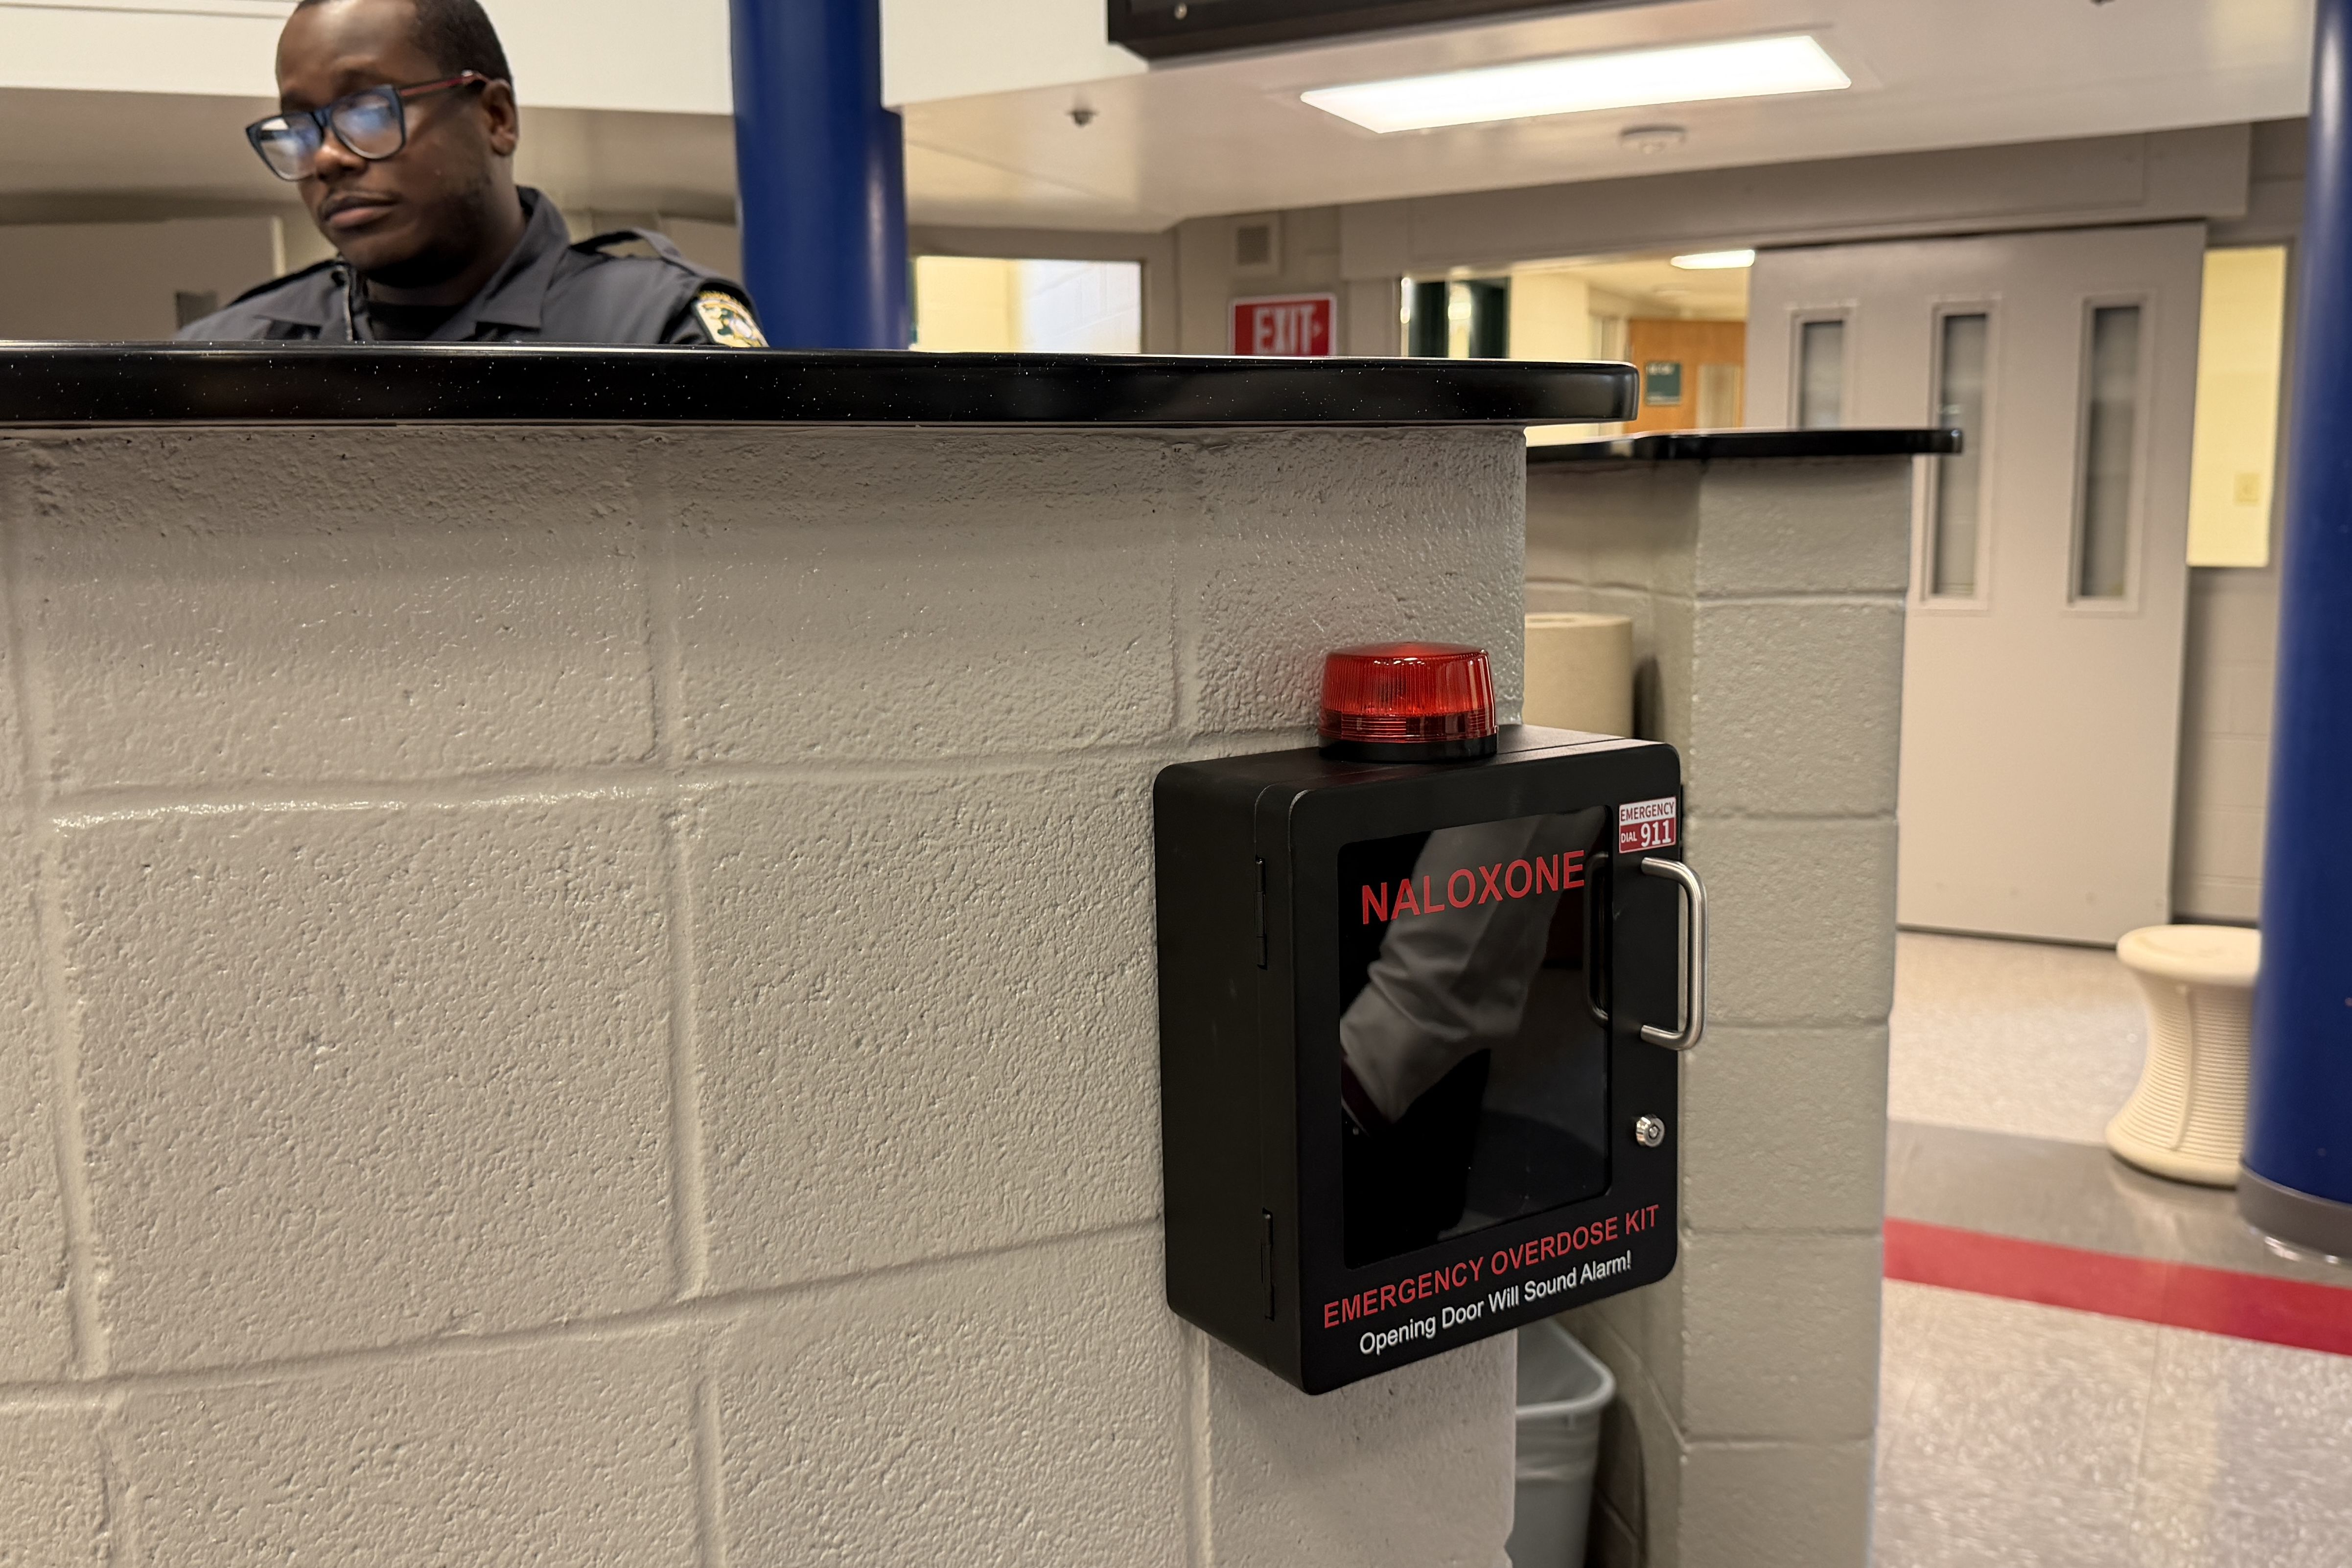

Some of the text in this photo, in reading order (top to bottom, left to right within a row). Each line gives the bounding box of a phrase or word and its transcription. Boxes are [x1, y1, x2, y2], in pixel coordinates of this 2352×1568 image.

[1254, 304, 1314, 355] EXIT
[1621, 802, 1674, 821] EMERGENCY
[1621, 820, 1671, 847] DIAL 911
[1362, 850, 1584, 925] NALOXONE
[1325, 1204, 1659, 1329] EMERGENCY OVERDOSE KIT
[1360, 1249, 1631, 1356] Opening Door Will Sound Alarm!
